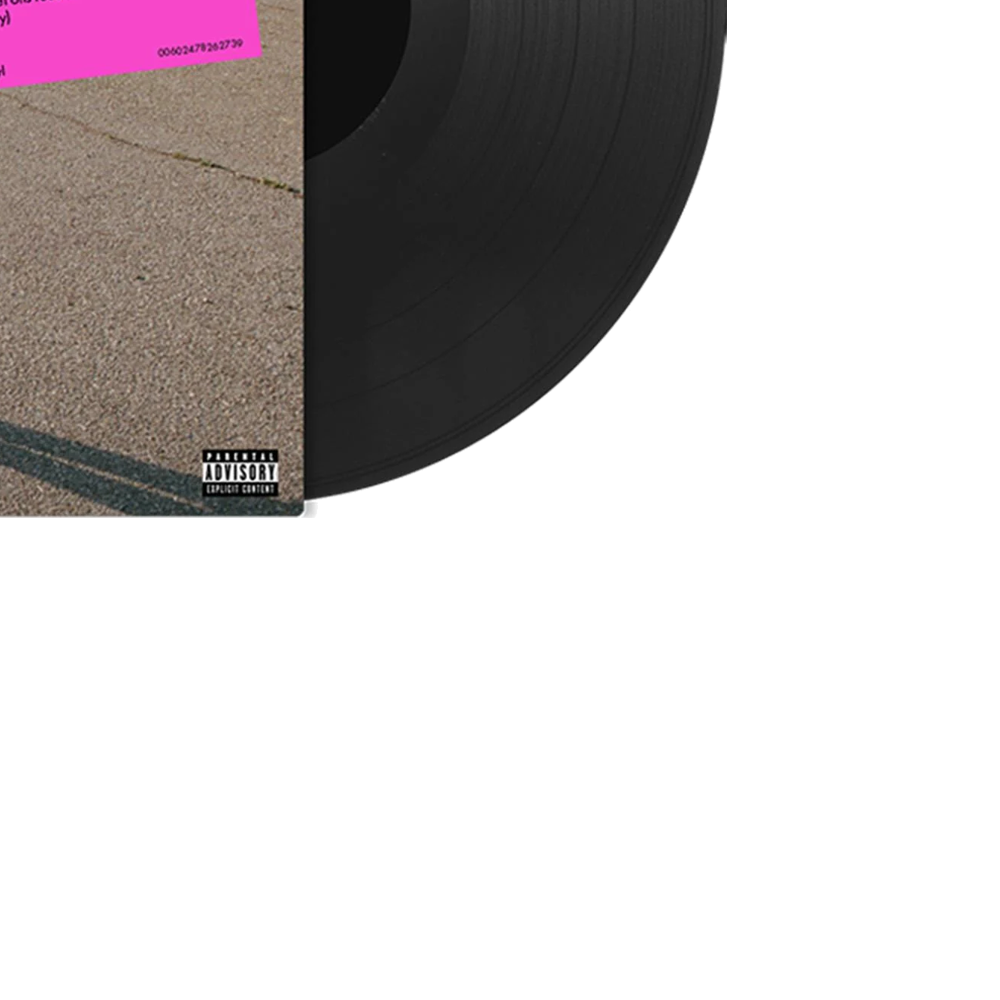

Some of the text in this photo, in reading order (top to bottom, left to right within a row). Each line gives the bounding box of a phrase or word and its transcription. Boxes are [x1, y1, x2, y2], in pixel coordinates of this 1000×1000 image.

[206, 452, 274, 461] PARENTAL
[205, 463, 275, 481] ADVISORY
[206, 484, 275, 494] EXPLICIT CONTENT
